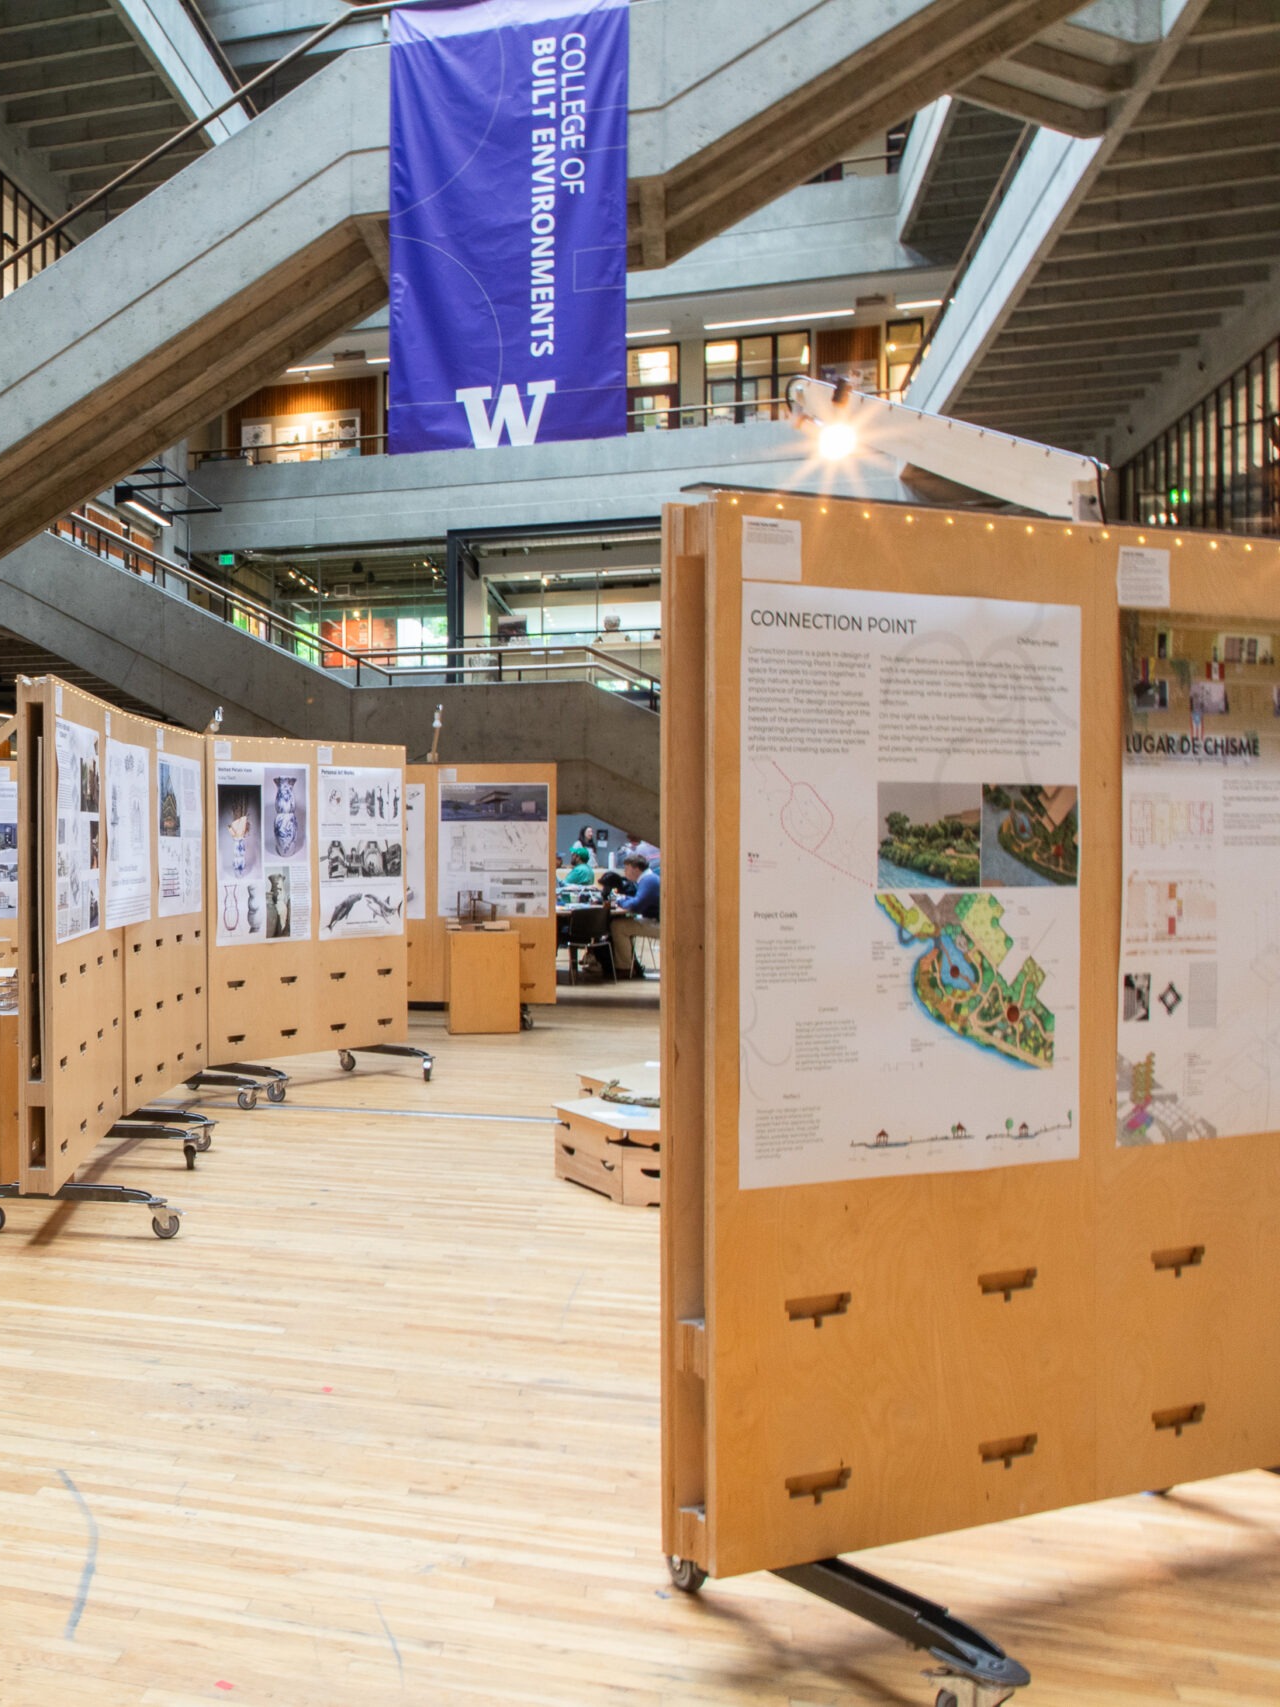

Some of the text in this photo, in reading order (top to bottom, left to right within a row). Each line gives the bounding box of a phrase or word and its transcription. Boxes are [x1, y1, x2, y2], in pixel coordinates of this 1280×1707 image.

[559, 32, 586, 194] COLLEGE OF
[530, 36, 556, 358] BUILT ENVIRONMENTS
[455, 379, 556, 449] W
[750, 610, 917, 635] CONNECTION POINT
[1126, 733, 1260, 757] LUGAR DE CHISME
[753, 911, 778, 920] Project
